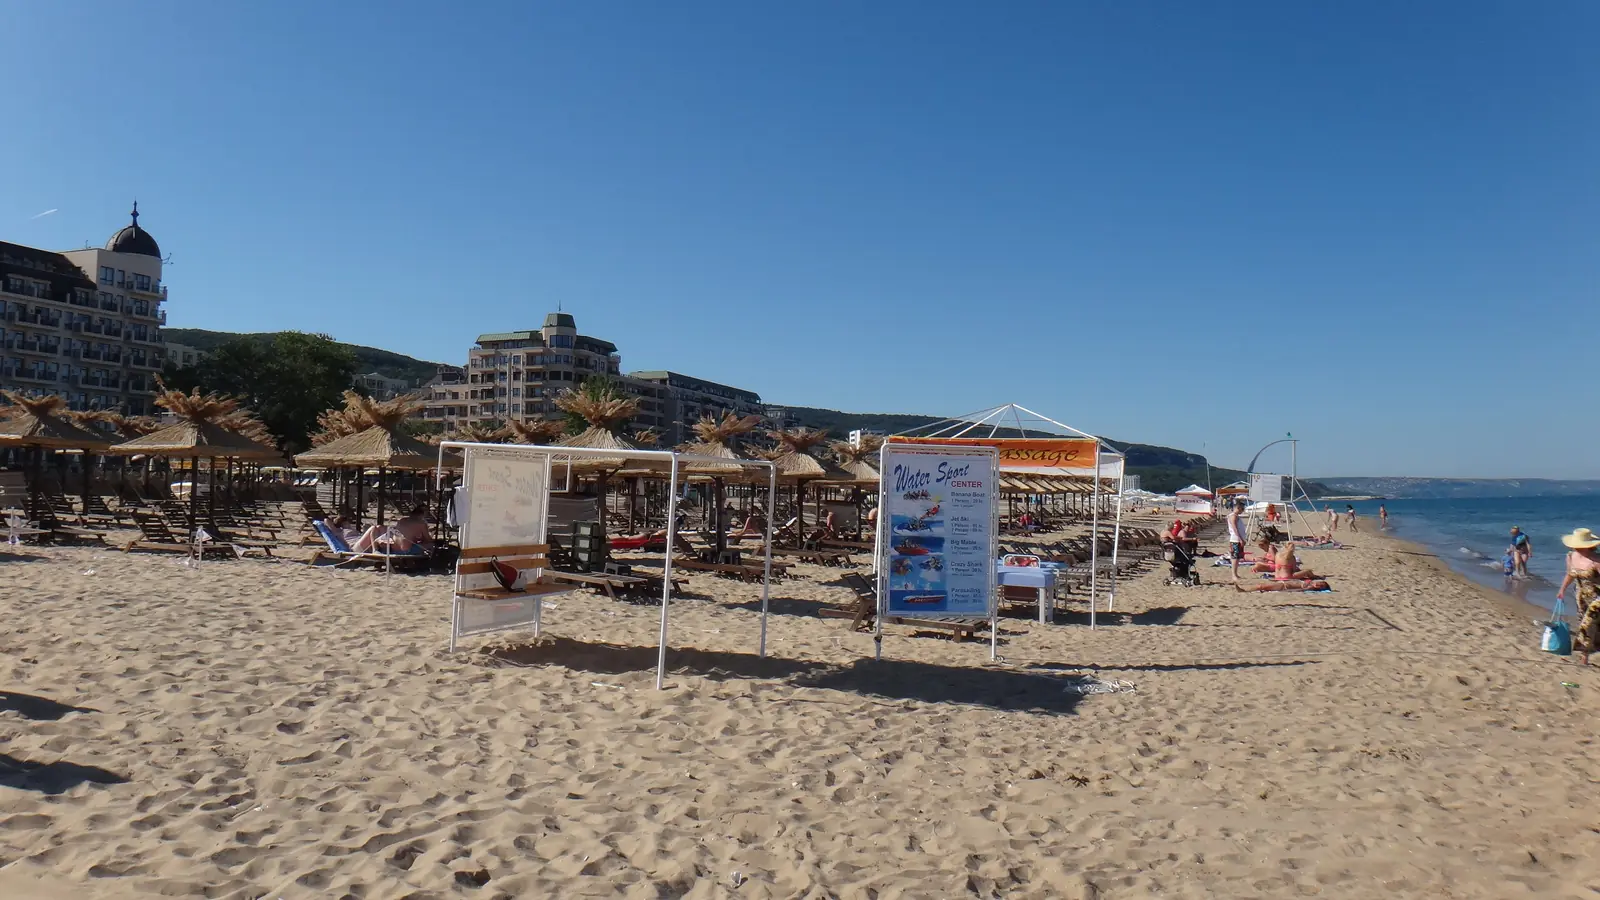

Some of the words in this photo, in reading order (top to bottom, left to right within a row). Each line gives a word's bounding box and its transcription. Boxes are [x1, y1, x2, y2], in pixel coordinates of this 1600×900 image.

[995, 443, 1080, 467] assage
[894, 464, 931, 493] Water
[936, 461, 970, 486] Sport
[950, 480, 983, 488] CENTER
